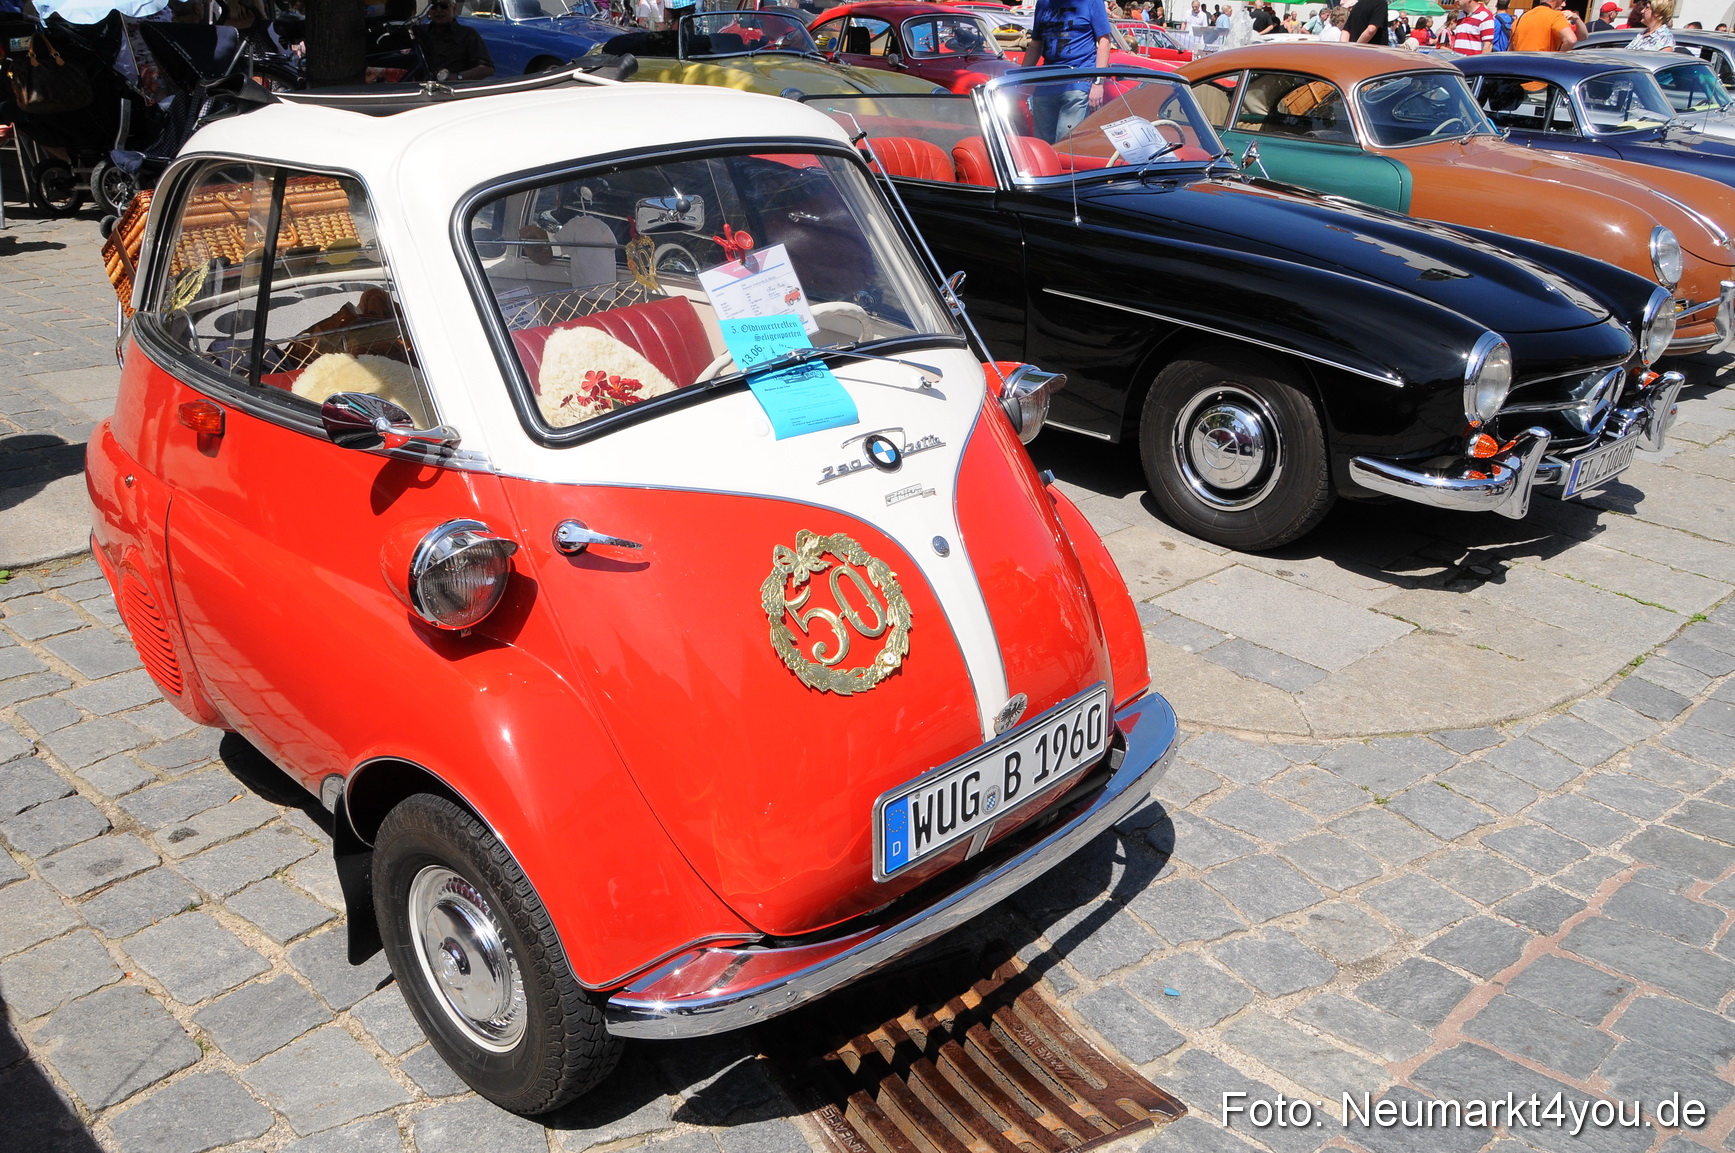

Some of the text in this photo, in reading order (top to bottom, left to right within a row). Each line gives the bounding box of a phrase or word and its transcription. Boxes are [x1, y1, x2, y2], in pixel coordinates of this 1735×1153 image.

[821, 459, 862, 480] 250
[785, 565, 887, 665] 50
[892, 703, 1102, 857] D WUG B 1960
